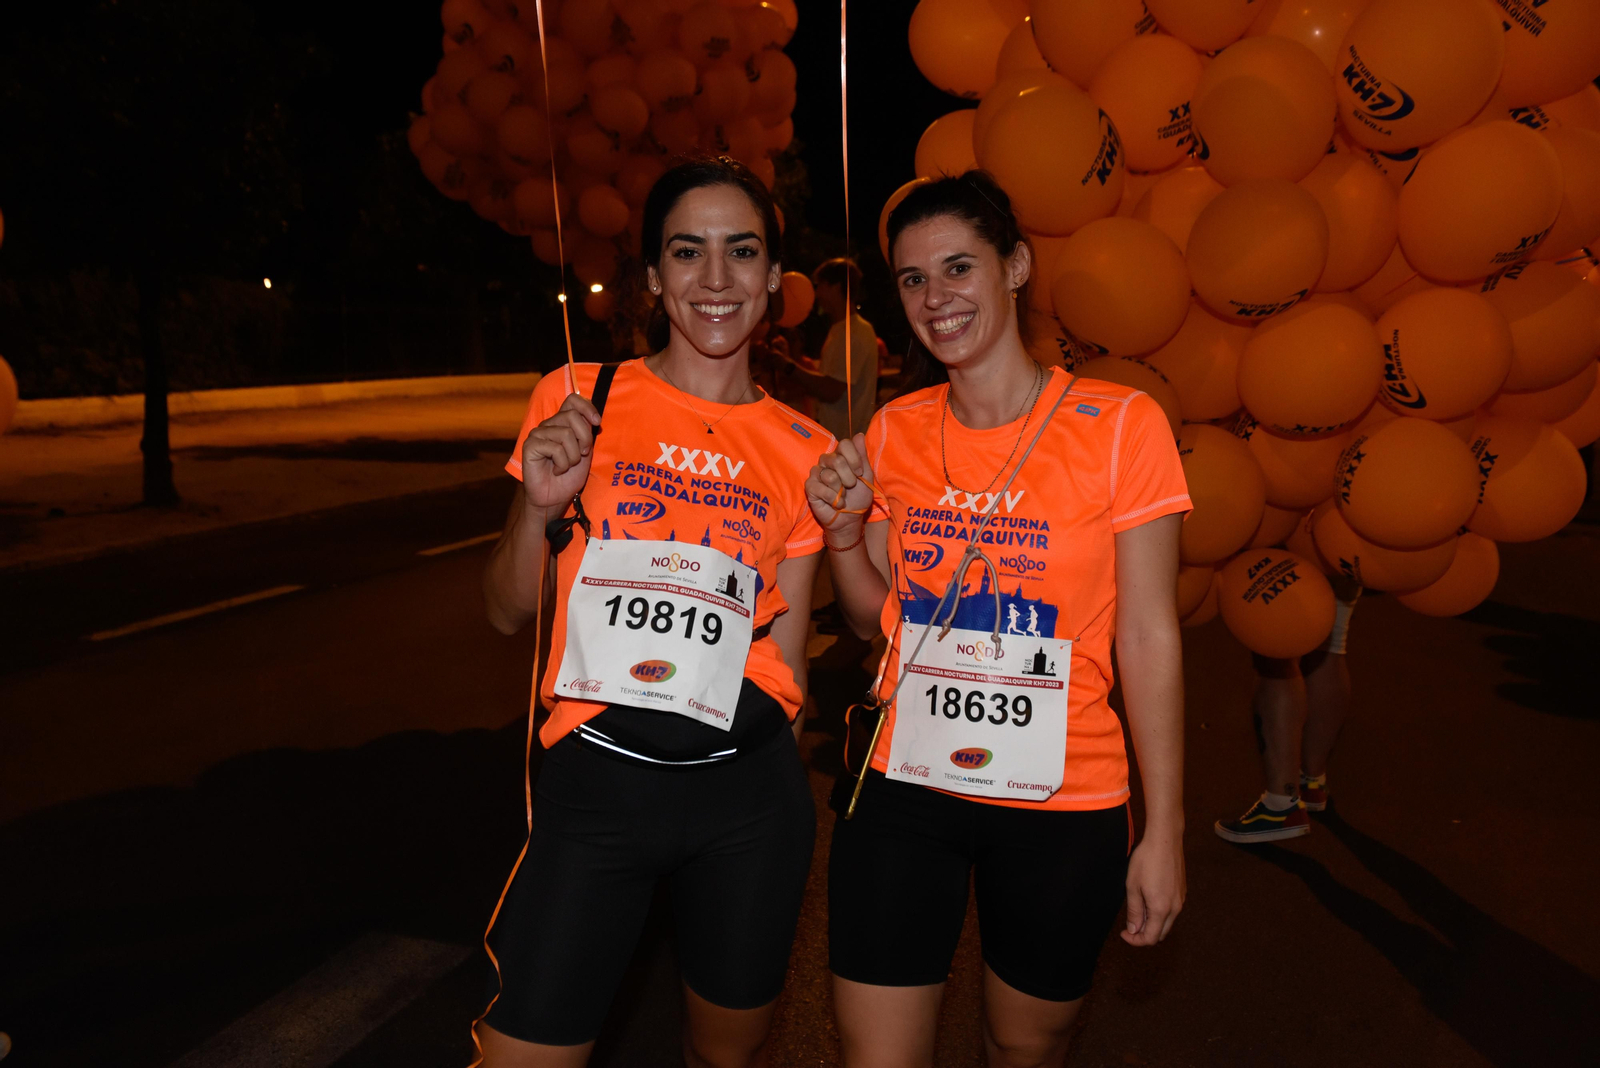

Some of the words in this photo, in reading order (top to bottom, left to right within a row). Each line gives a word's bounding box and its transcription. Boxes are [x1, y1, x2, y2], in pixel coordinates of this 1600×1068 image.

[1349, 44, 1382, 89] NOCTURNA
[1352, 109, 1392, 136] SEVILLA
[1392, 329, 1407, 380] NOCTURNA
[655, 442, 746, 480] XXXV
[611, 471, 621, 487] DEL
[623, 473, 768, 522] GUADALQUIVIR
[615, 461, 684, 486] CARRERA
[691, 478, 770, 507] NOCTURNA
[938, 485, 1025, 514] XXXV
[907, 506, 964, 524] CARRERA
[970, 514, 1050, 532] NOCTURNA
[910, 521, 1049, 550] GUADALQUIVIR
[604, 580, 632, 588] CARRERA
[668, 585, 679, 593] DEL
[680, 588, 725, 605] GUADALQUIVIR
[1261, 569, 1301, 605] XXXV
[604, 594, 723, 645] 19819
[921, 667, 944, 676] CARRERA
[944, 670, 976, 680] NOCTURNA
[987, 675, 1032, 686] GUADALQUIVIR
[688, 697, 726, 720] Cruzcampo
[925, 684, 1033, 727] 18639
[1007, 780, 1053, 793] Cruzcampo
